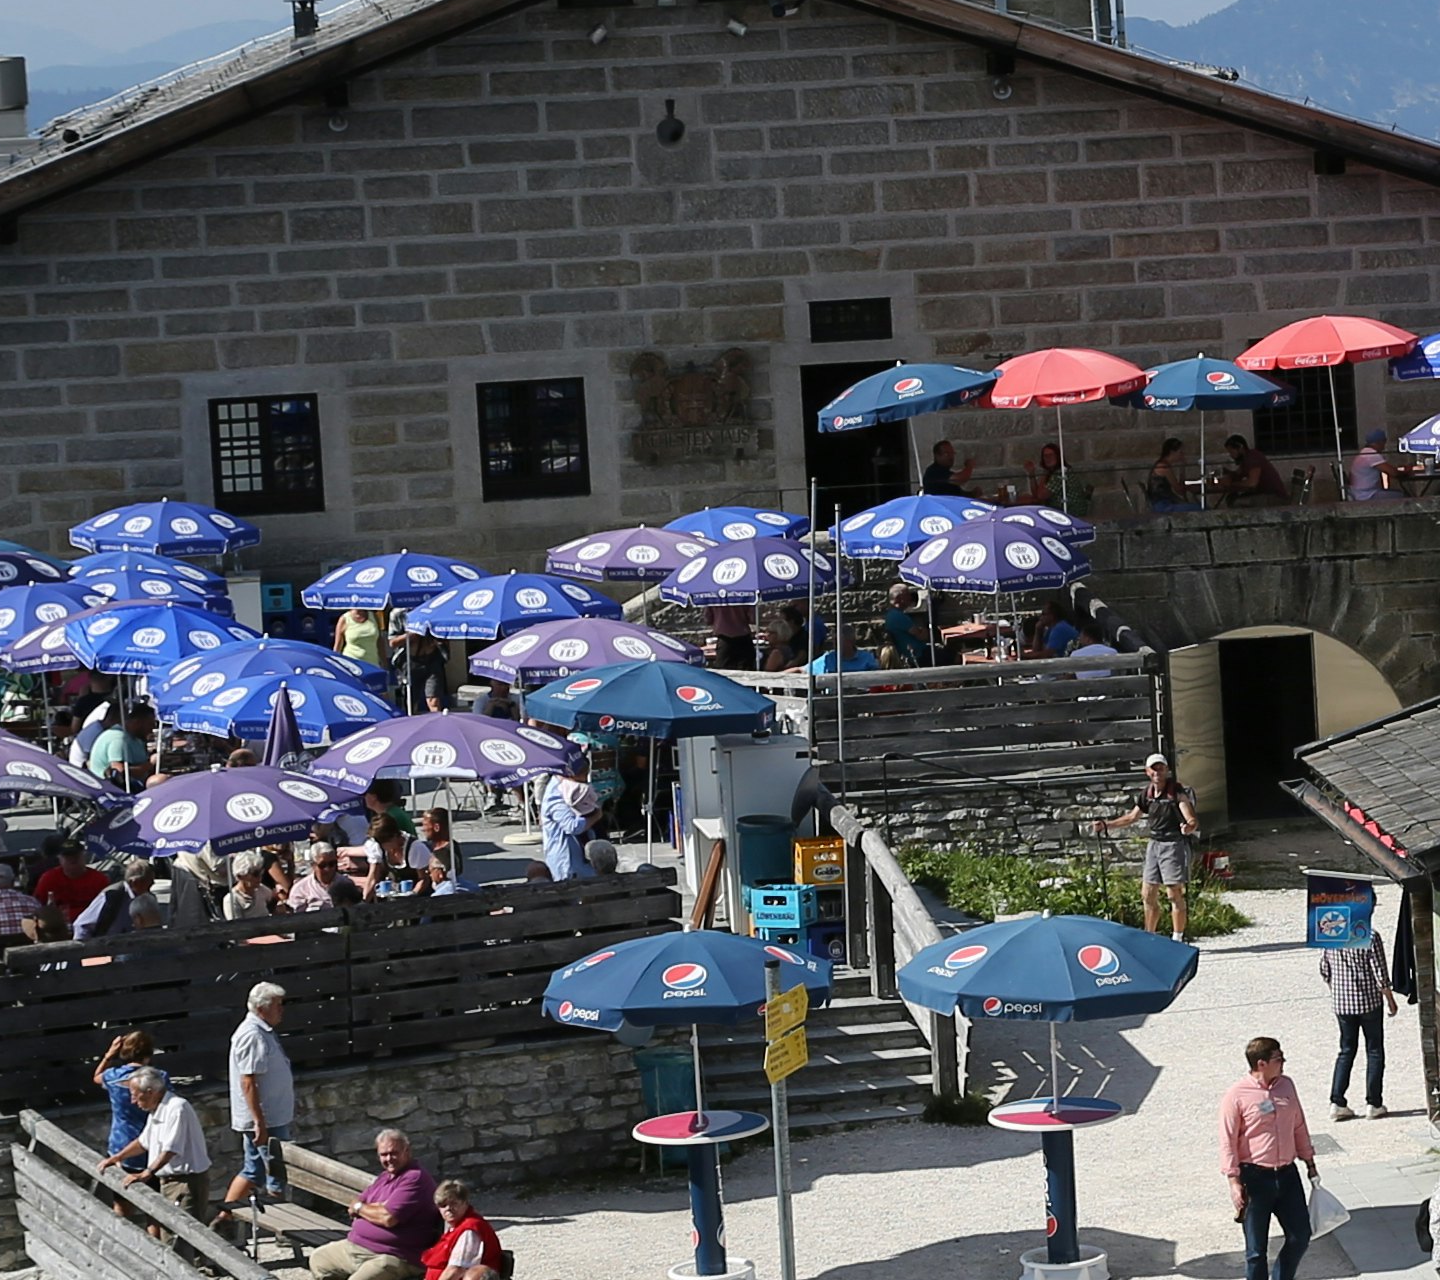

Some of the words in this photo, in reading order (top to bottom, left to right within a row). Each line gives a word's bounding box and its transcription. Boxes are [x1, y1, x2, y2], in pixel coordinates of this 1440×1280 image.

[1294, 356, 1317, 365] Coca-Cola
[1155, 398, 1178, 406] pepsi
[843, 415, 863, 427] pepsi
[960, 555, 976, 565] HB
[1015, 554, 1033, 564] HB
[721, 568, 737, 579] HB
[776, 564, 792, 575] HB
[560, 648, 577, 658] HB
[617, 721, 647, 731] pepsi
[423, 755, 443, 765] HB
[242, 805, 263, 817] HB
[163, 815, 182, 826] HB
[218, 832, 253, 848] HOFBRÄU
[266, 823, 307, 836] MÜNCHEN
[927, 966, 958, 978] pepsi
[1096, 974, 1132, 988] pepsi
[663, 989, 707, 1000] pepsi
[1004, 1002, 1042, 1015] pepsi
[572, 1008, 599, 1021] pepsi
